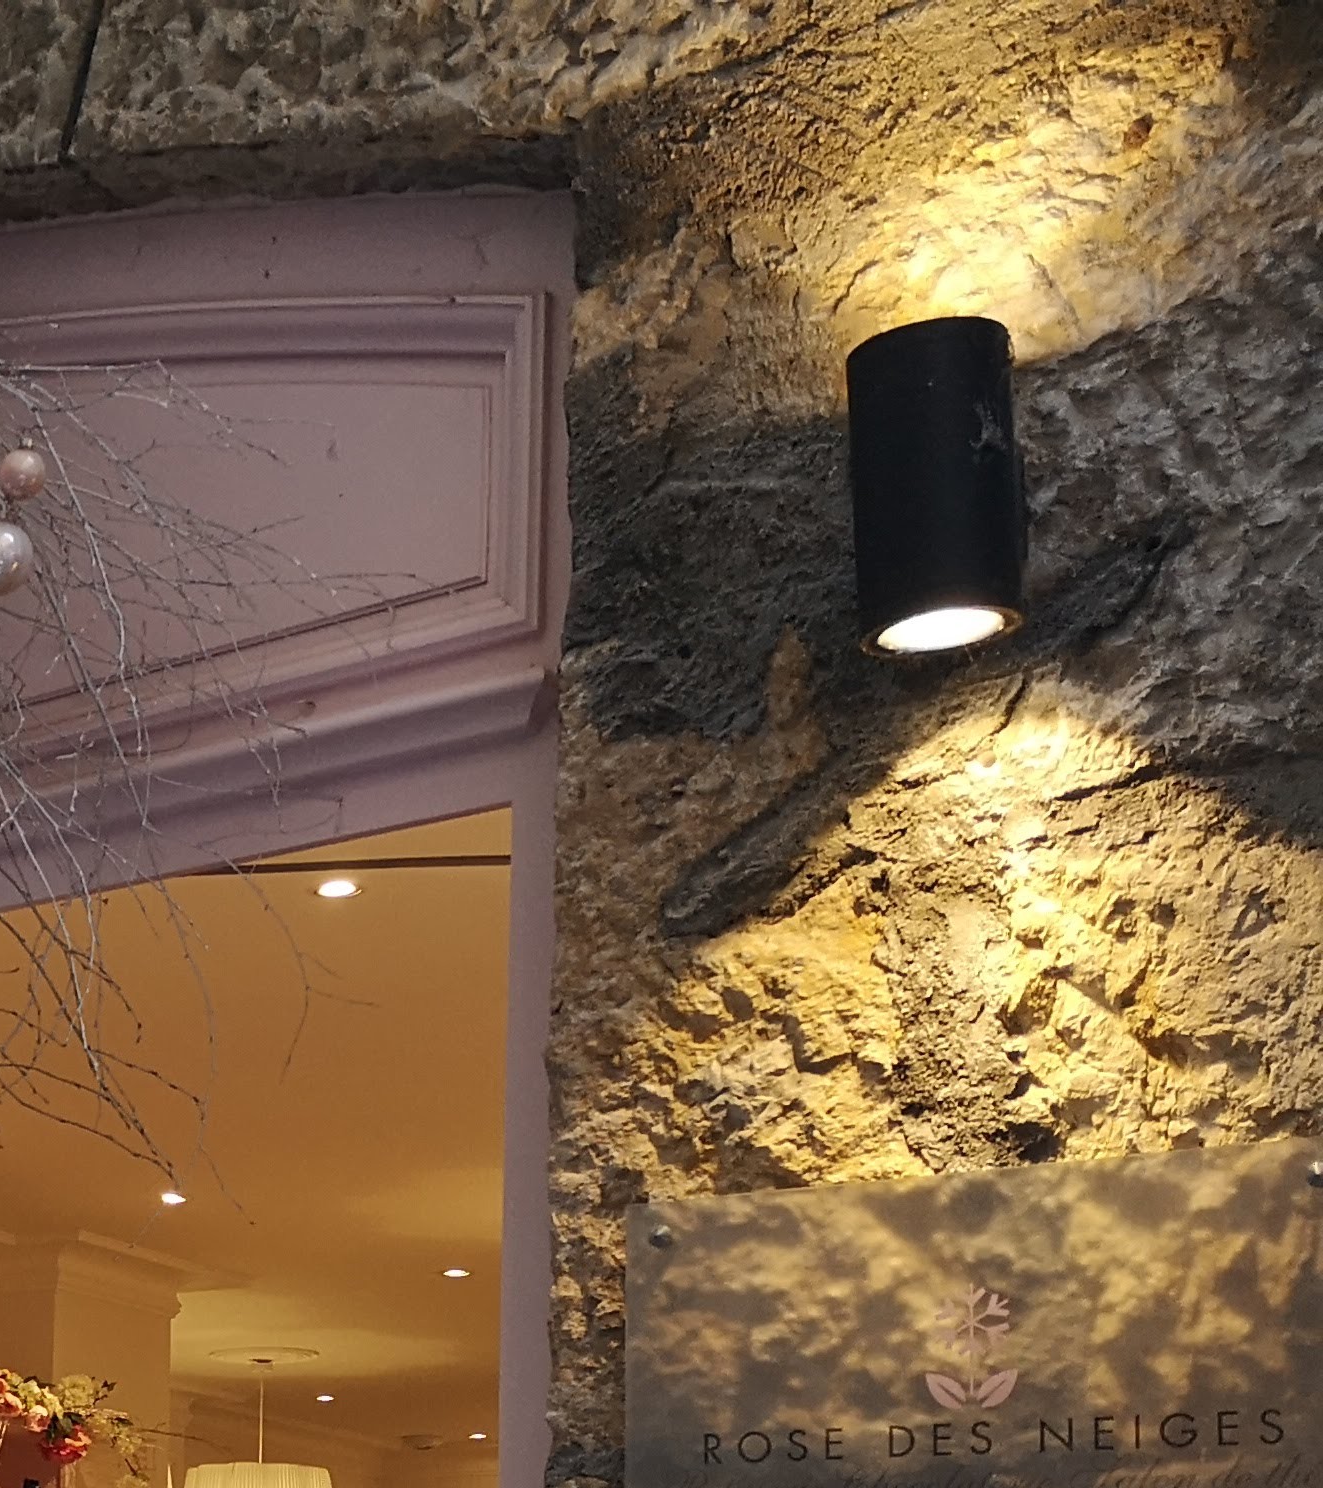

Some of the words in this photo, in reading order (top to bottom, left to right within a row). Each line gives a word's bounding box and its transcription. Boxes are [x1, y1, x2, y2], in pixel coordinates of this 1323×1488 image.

[703, 1428, 845, 1465] ROSE
[888, 1420, 993, 1458] DES
[1039, 1408, 1285, 1453] NEIGES
